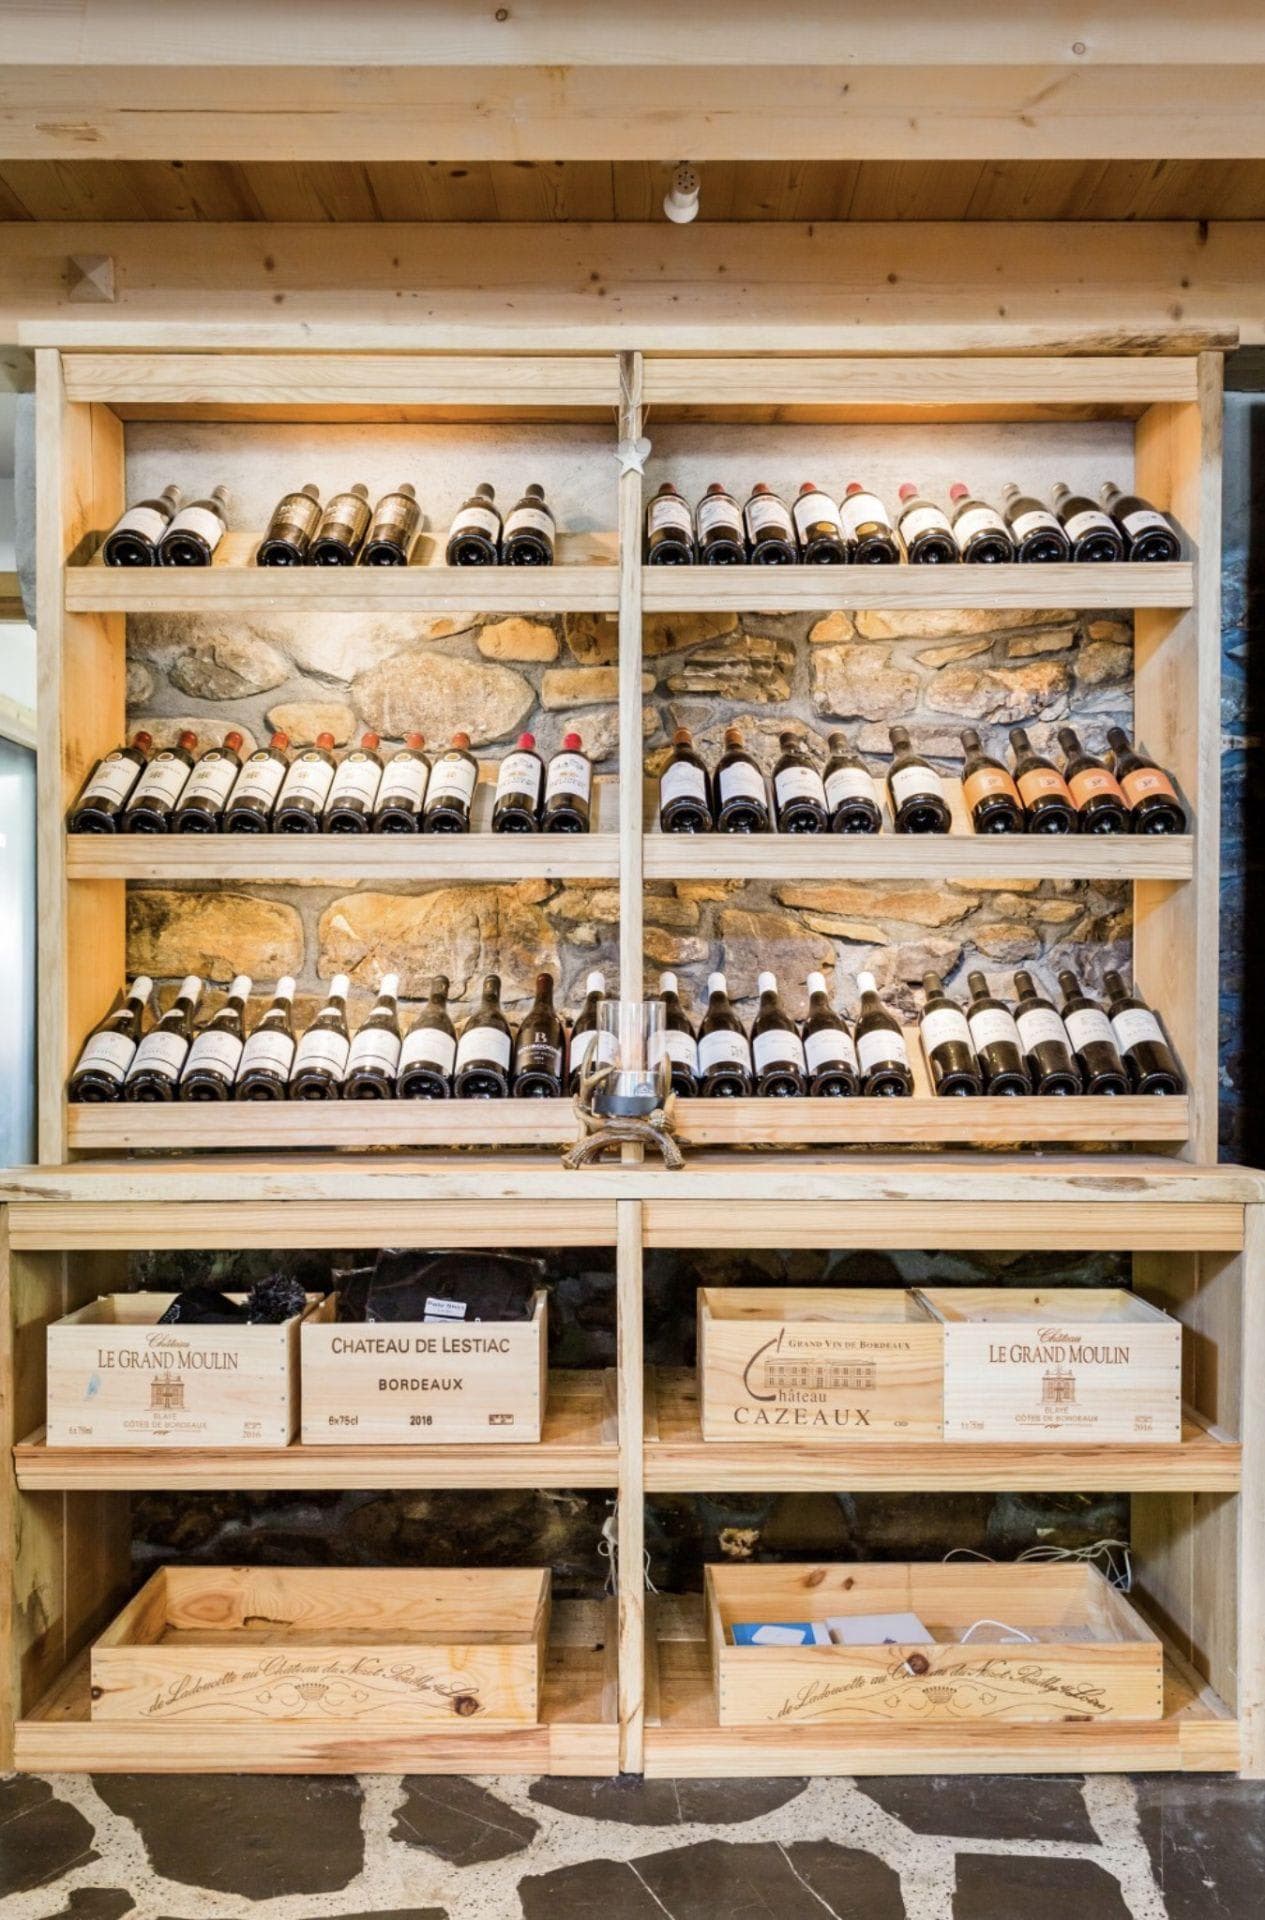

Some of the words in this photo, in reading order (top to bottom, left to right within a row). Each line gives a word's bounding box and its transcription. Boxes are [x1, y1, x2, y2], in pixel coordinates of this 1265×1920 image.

[1037, 1327, 1082, 1343] Château
[331, 1337, 410, 1354] CHATEAU
[416, 1339, 437, 1353] DE
[442, 1337, 510, 1354] LESTIAC
[788, 1339, 823, 1350] GRAND
[825, 1338, 843, 1350] VIN
[859, 1340, 911, 1351] BORDEAUX
[97, 1349, 115, 1368] LE
[118, 1349, 174, 1369] GRAND
[177, 1351, 239, 1370] MOULIN
[989, 1345, 1007, 1363] LE
[1010, 1344, 1066, 1364] GRAND
[1069, 1346, 1130, 1364] MOULIN
[378, 1379, 464, 1391] BORDEAUX
[328, 1415, 359, 1427] 6x75cl
[733, 1407, 871, 1426] CAZEAUX
